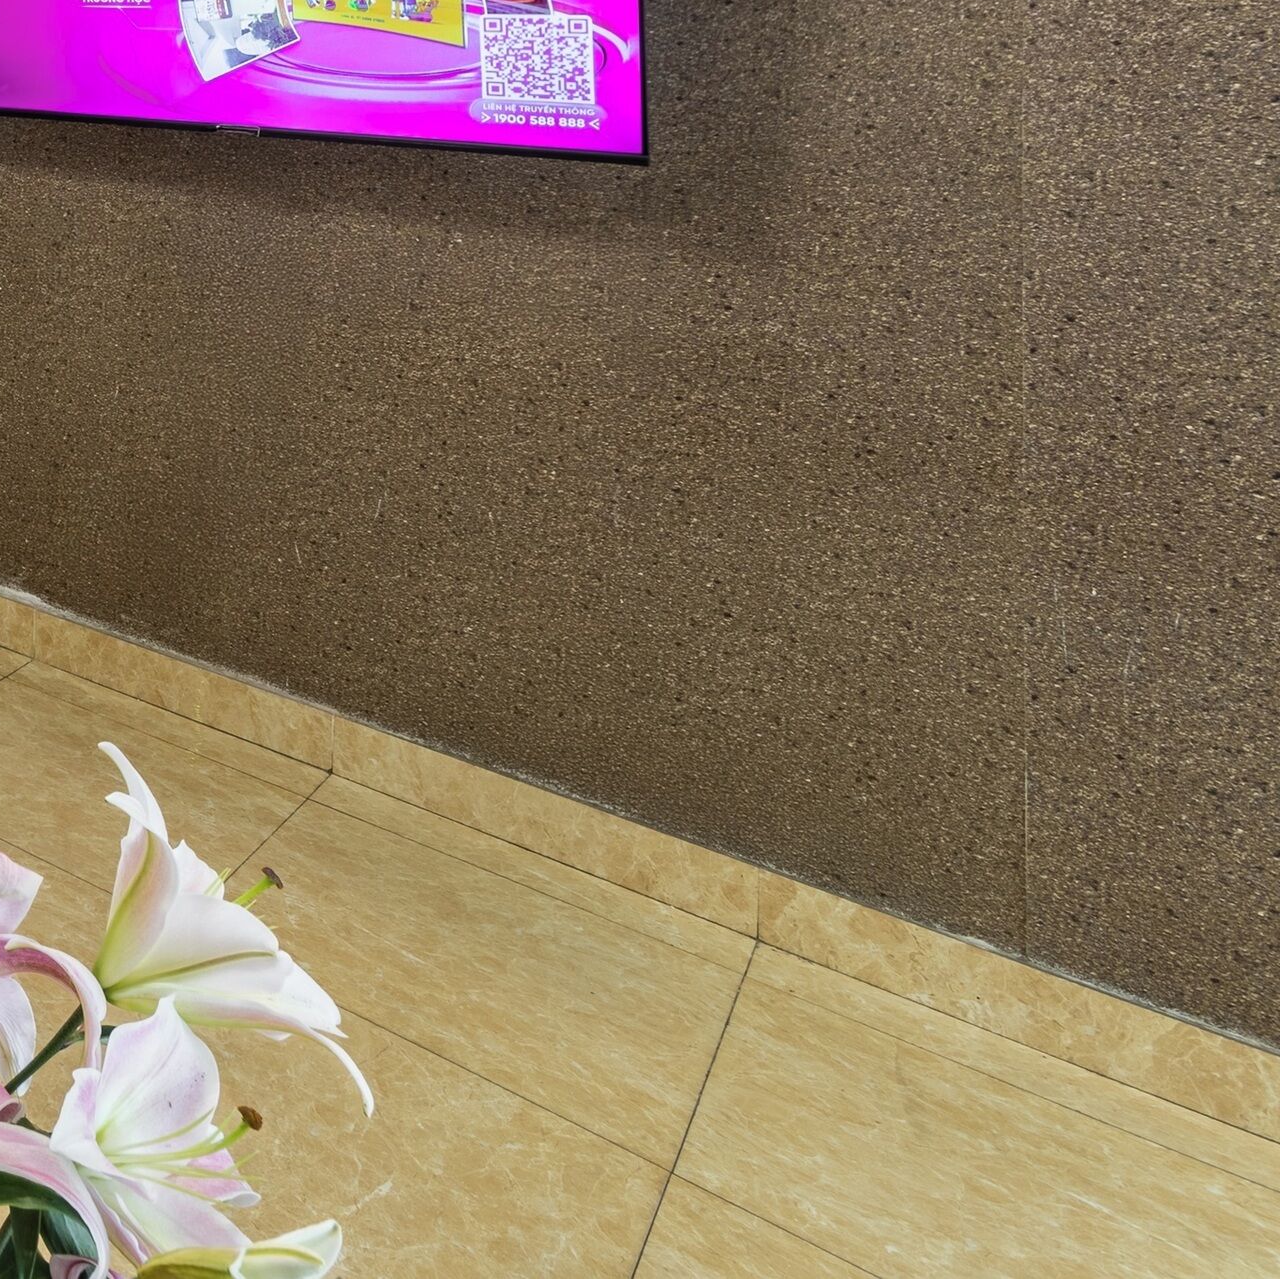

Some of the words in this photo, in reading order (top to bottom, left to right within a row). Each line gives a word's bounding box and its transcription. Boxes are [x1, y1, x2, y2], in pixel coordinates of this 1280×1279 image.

[483, 102, 502, 111] LIÊN
[505, 103, 516, 113] HỆ
[520, 104, 556, 114] TRUYỀN
[559, 105, 595, 116] THÔNG
[493, 113, 526, 125] 1900
[530, 115, 555, 126] 588
[559, 117, 586, 128] 888
